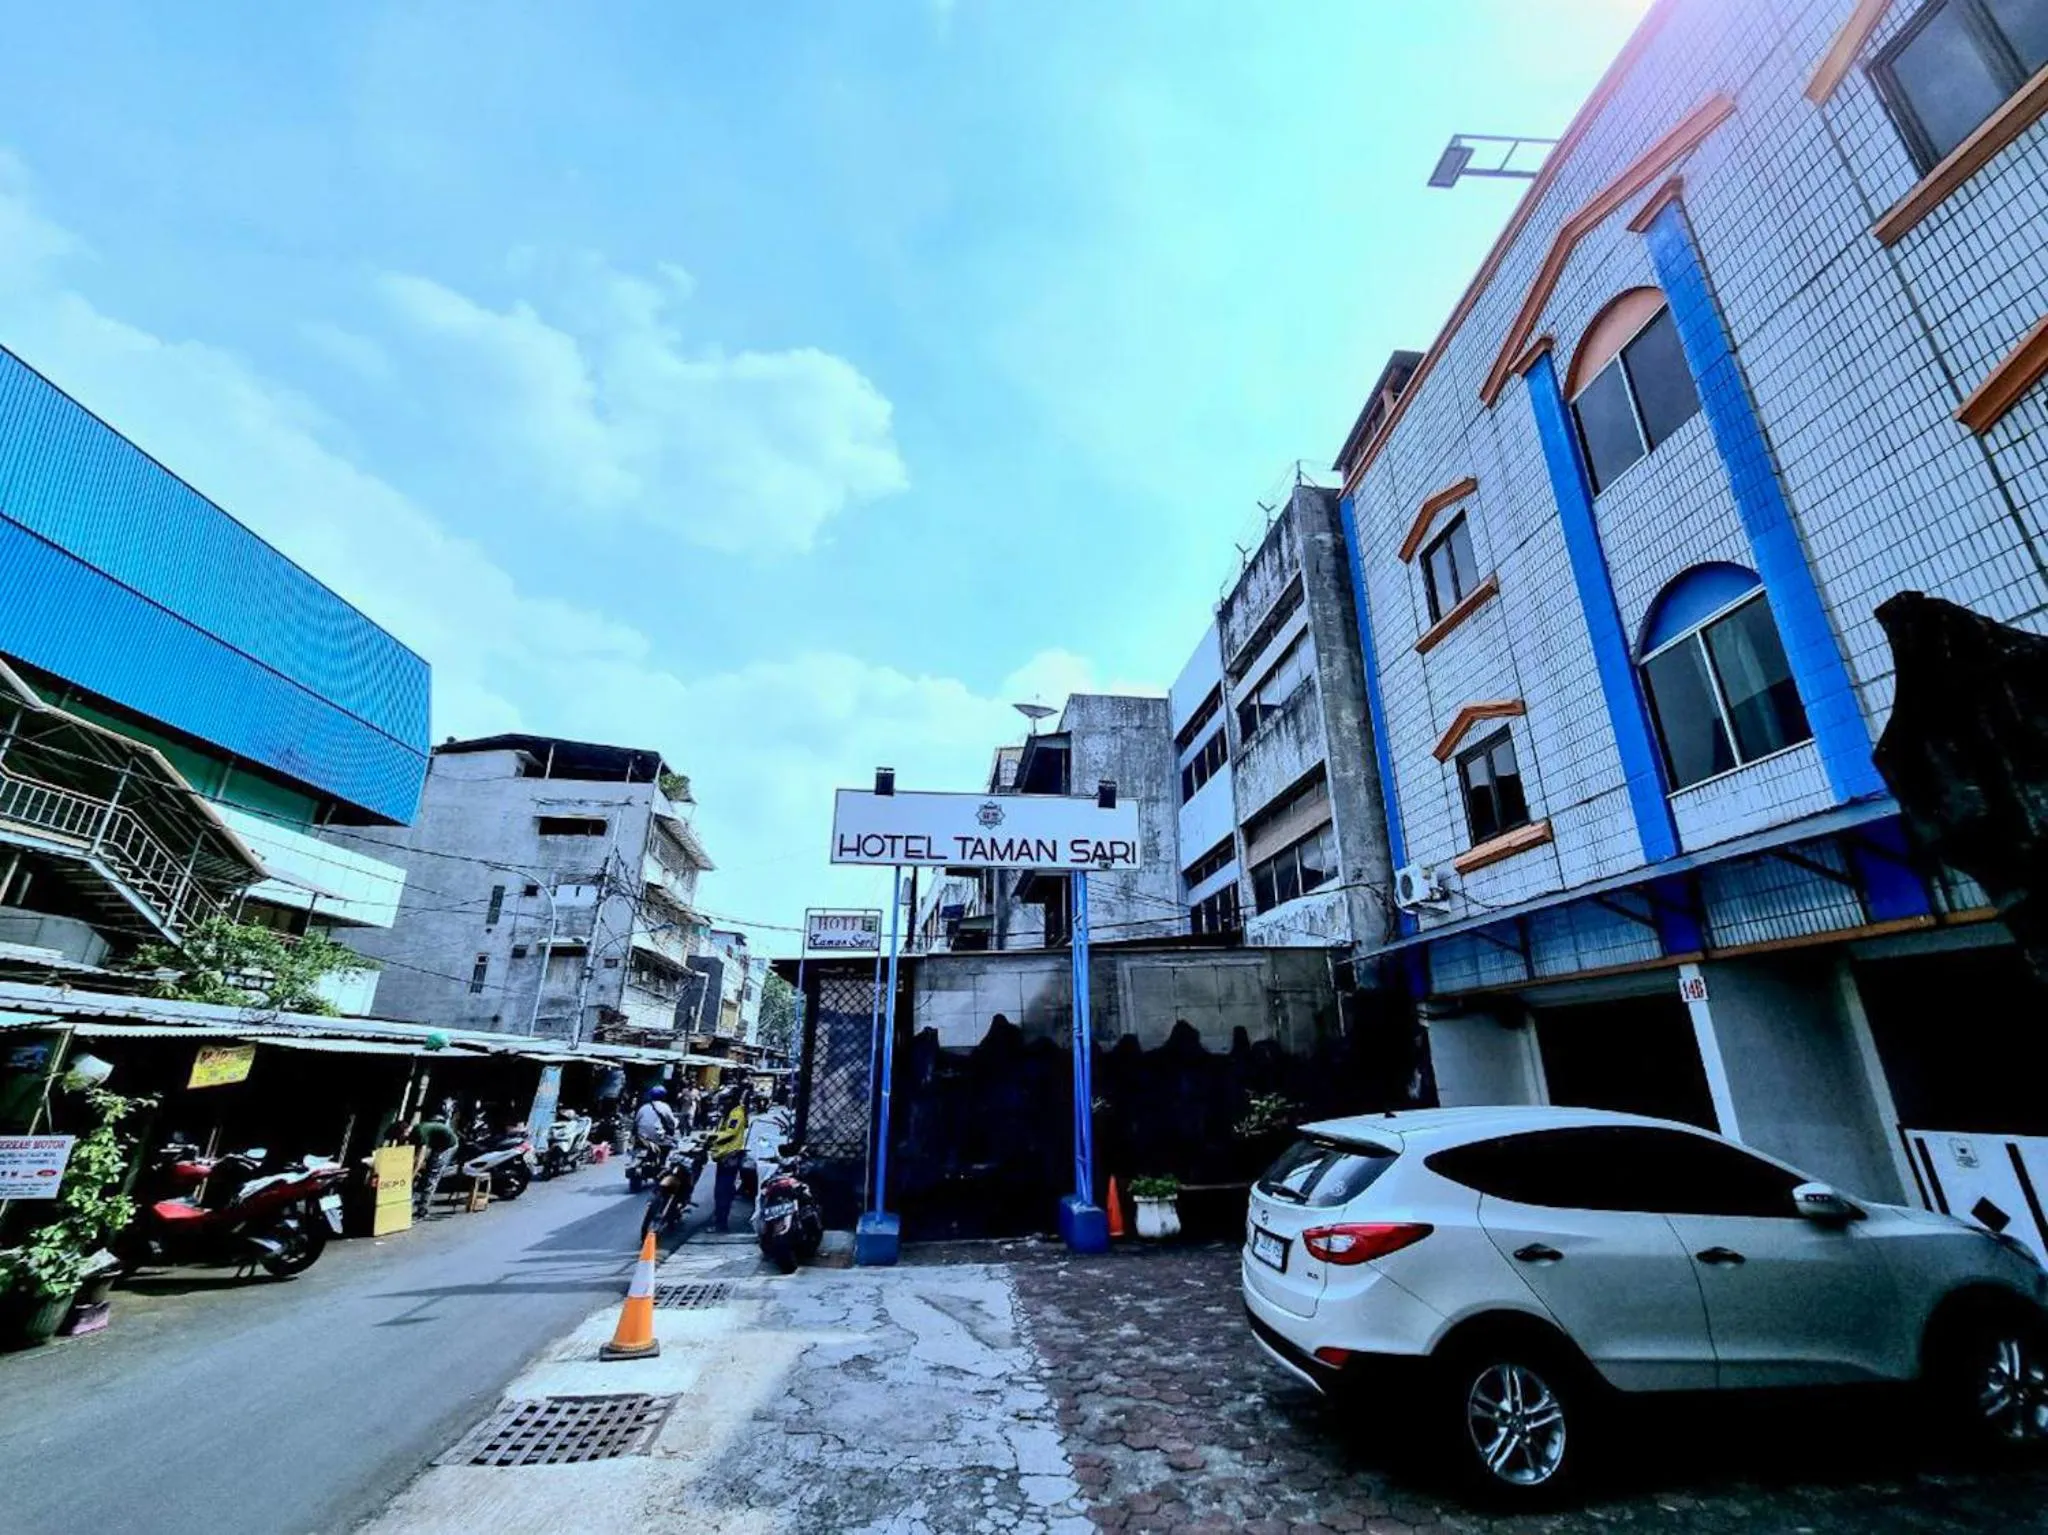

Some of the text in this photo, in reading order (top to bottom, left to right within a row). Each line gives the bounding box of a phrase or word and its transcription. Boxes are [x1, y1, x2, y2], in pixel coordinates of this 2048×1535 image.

[839, 833, 1137, 865] HOTEL TAMAN SARI
[811, 932, 848, 947] Taman
